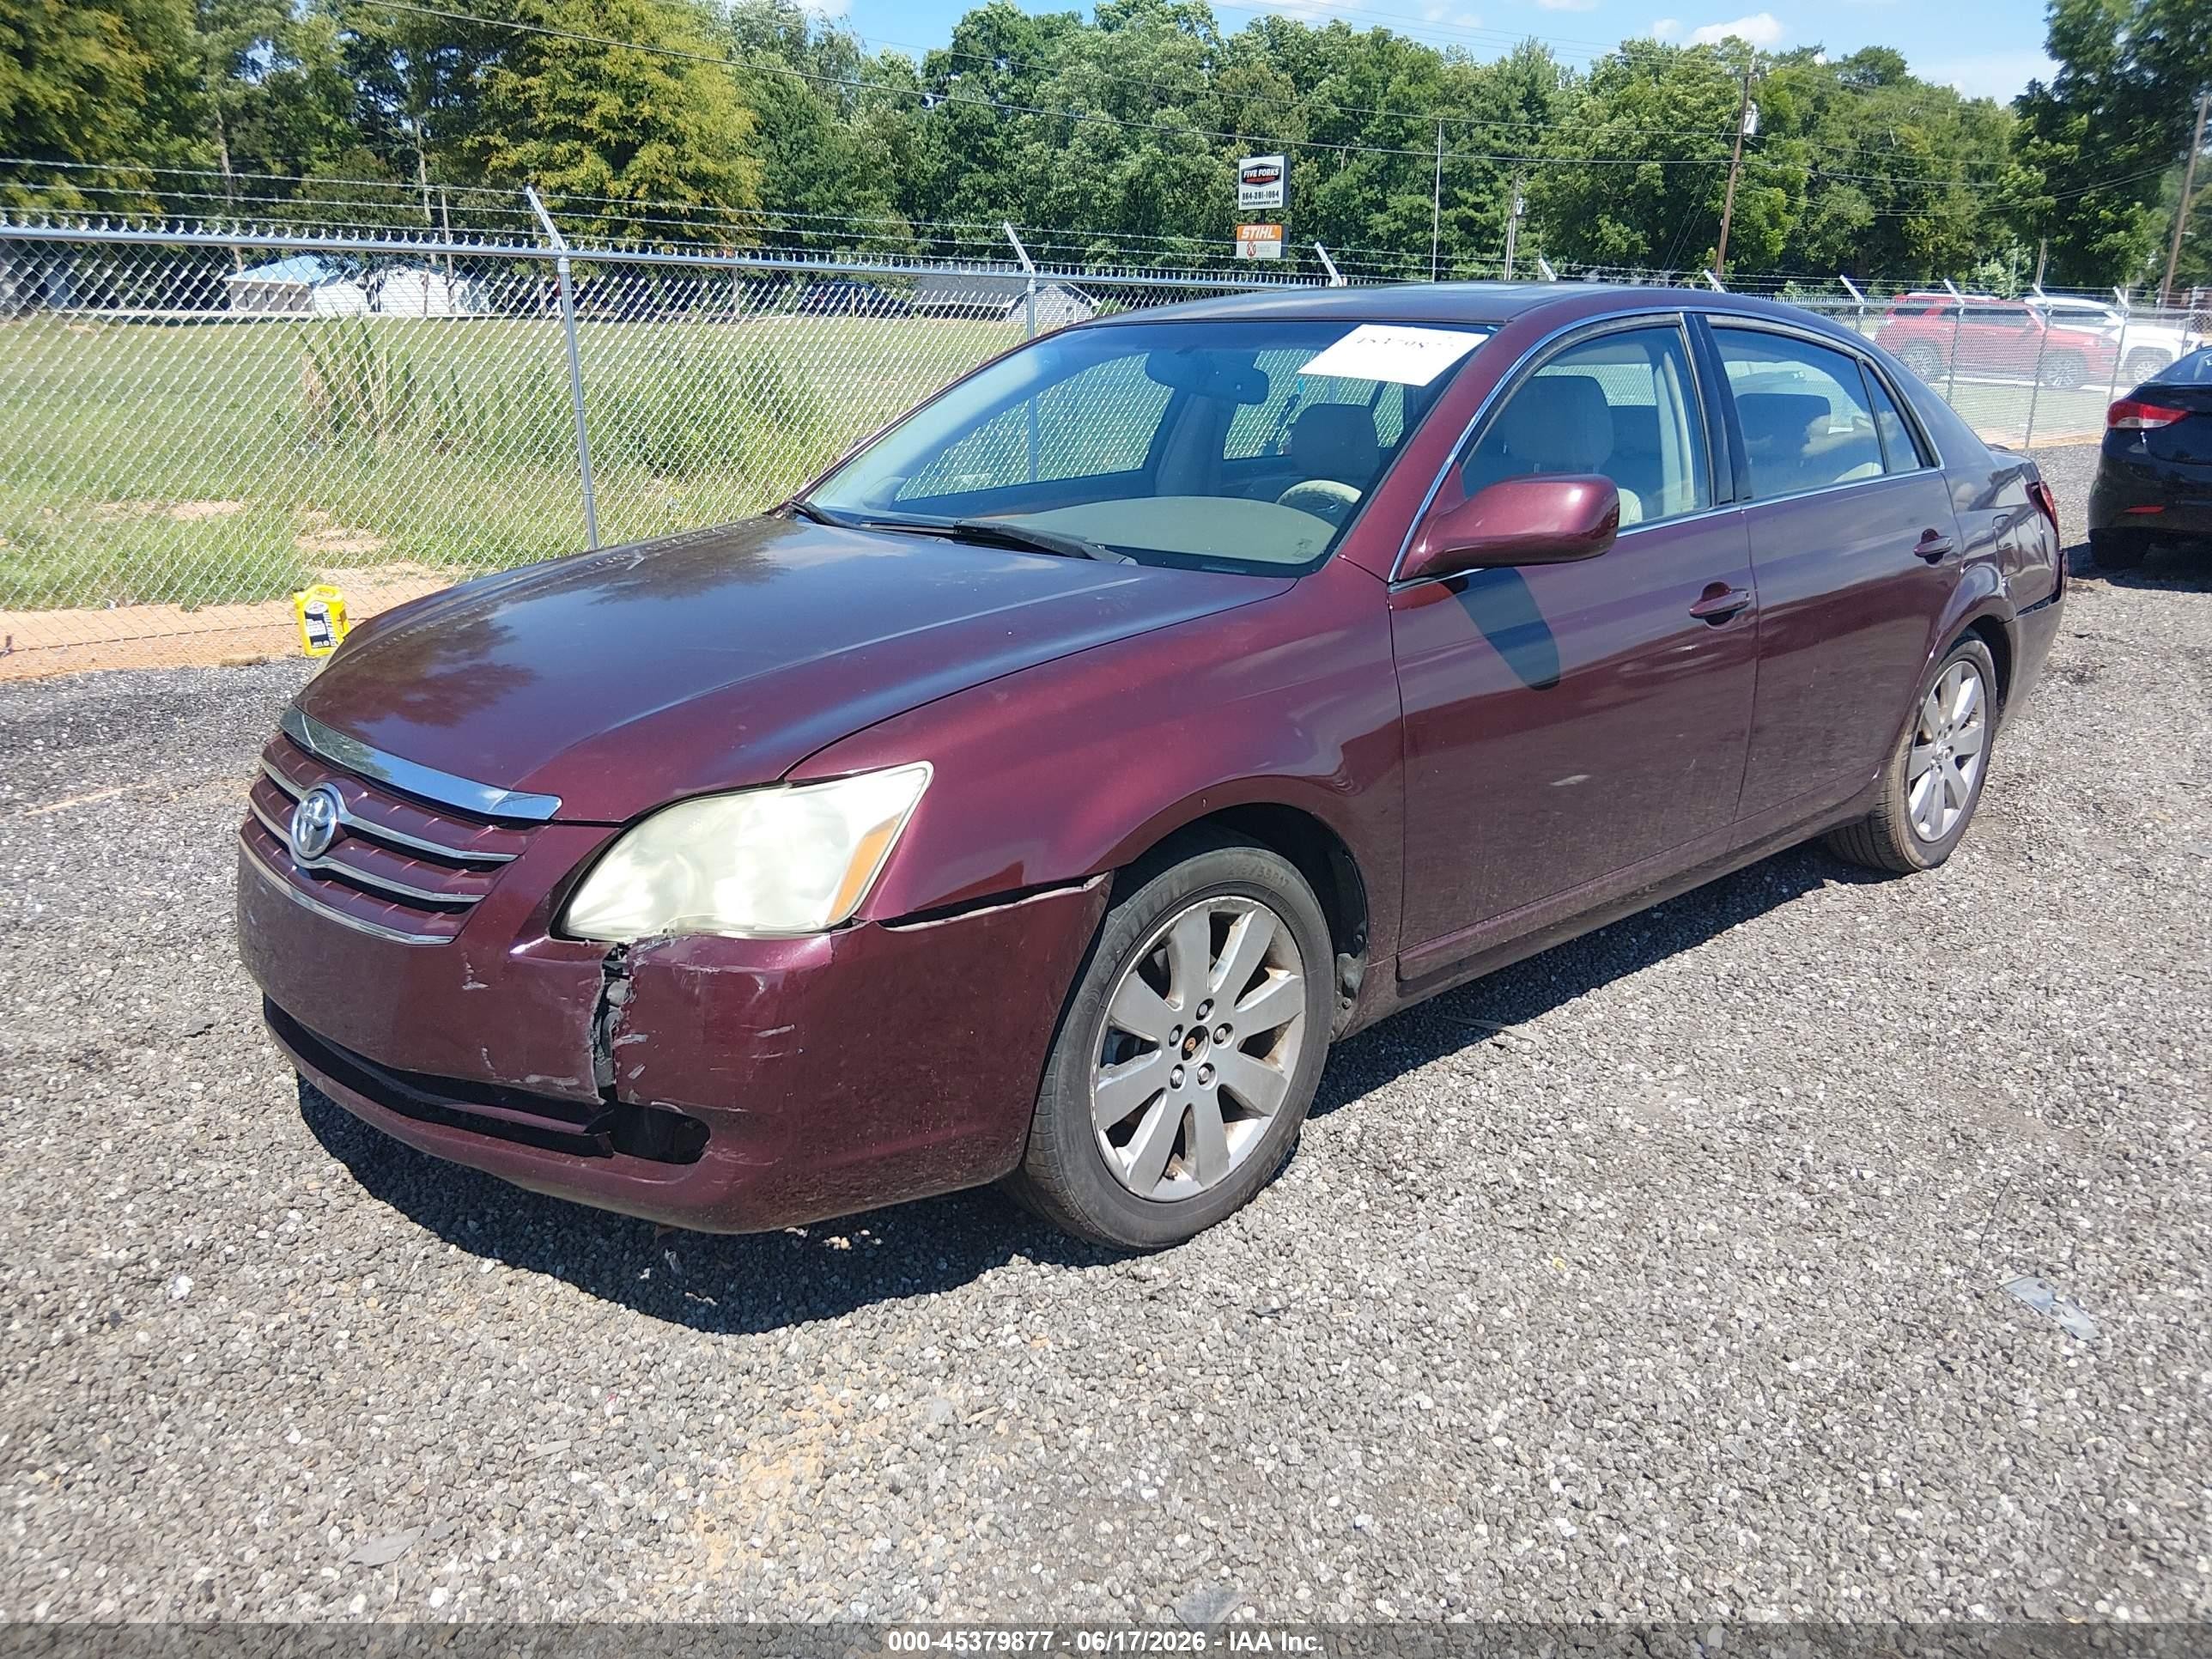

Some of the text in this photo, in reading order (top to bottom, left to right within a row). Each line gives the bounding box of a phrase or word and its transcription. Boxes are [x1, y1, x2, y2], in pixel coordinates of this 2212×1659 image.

[1243, 167, 1279, 179] FIVE FORKS
[1242, 226, 1276, 239] STIHL
